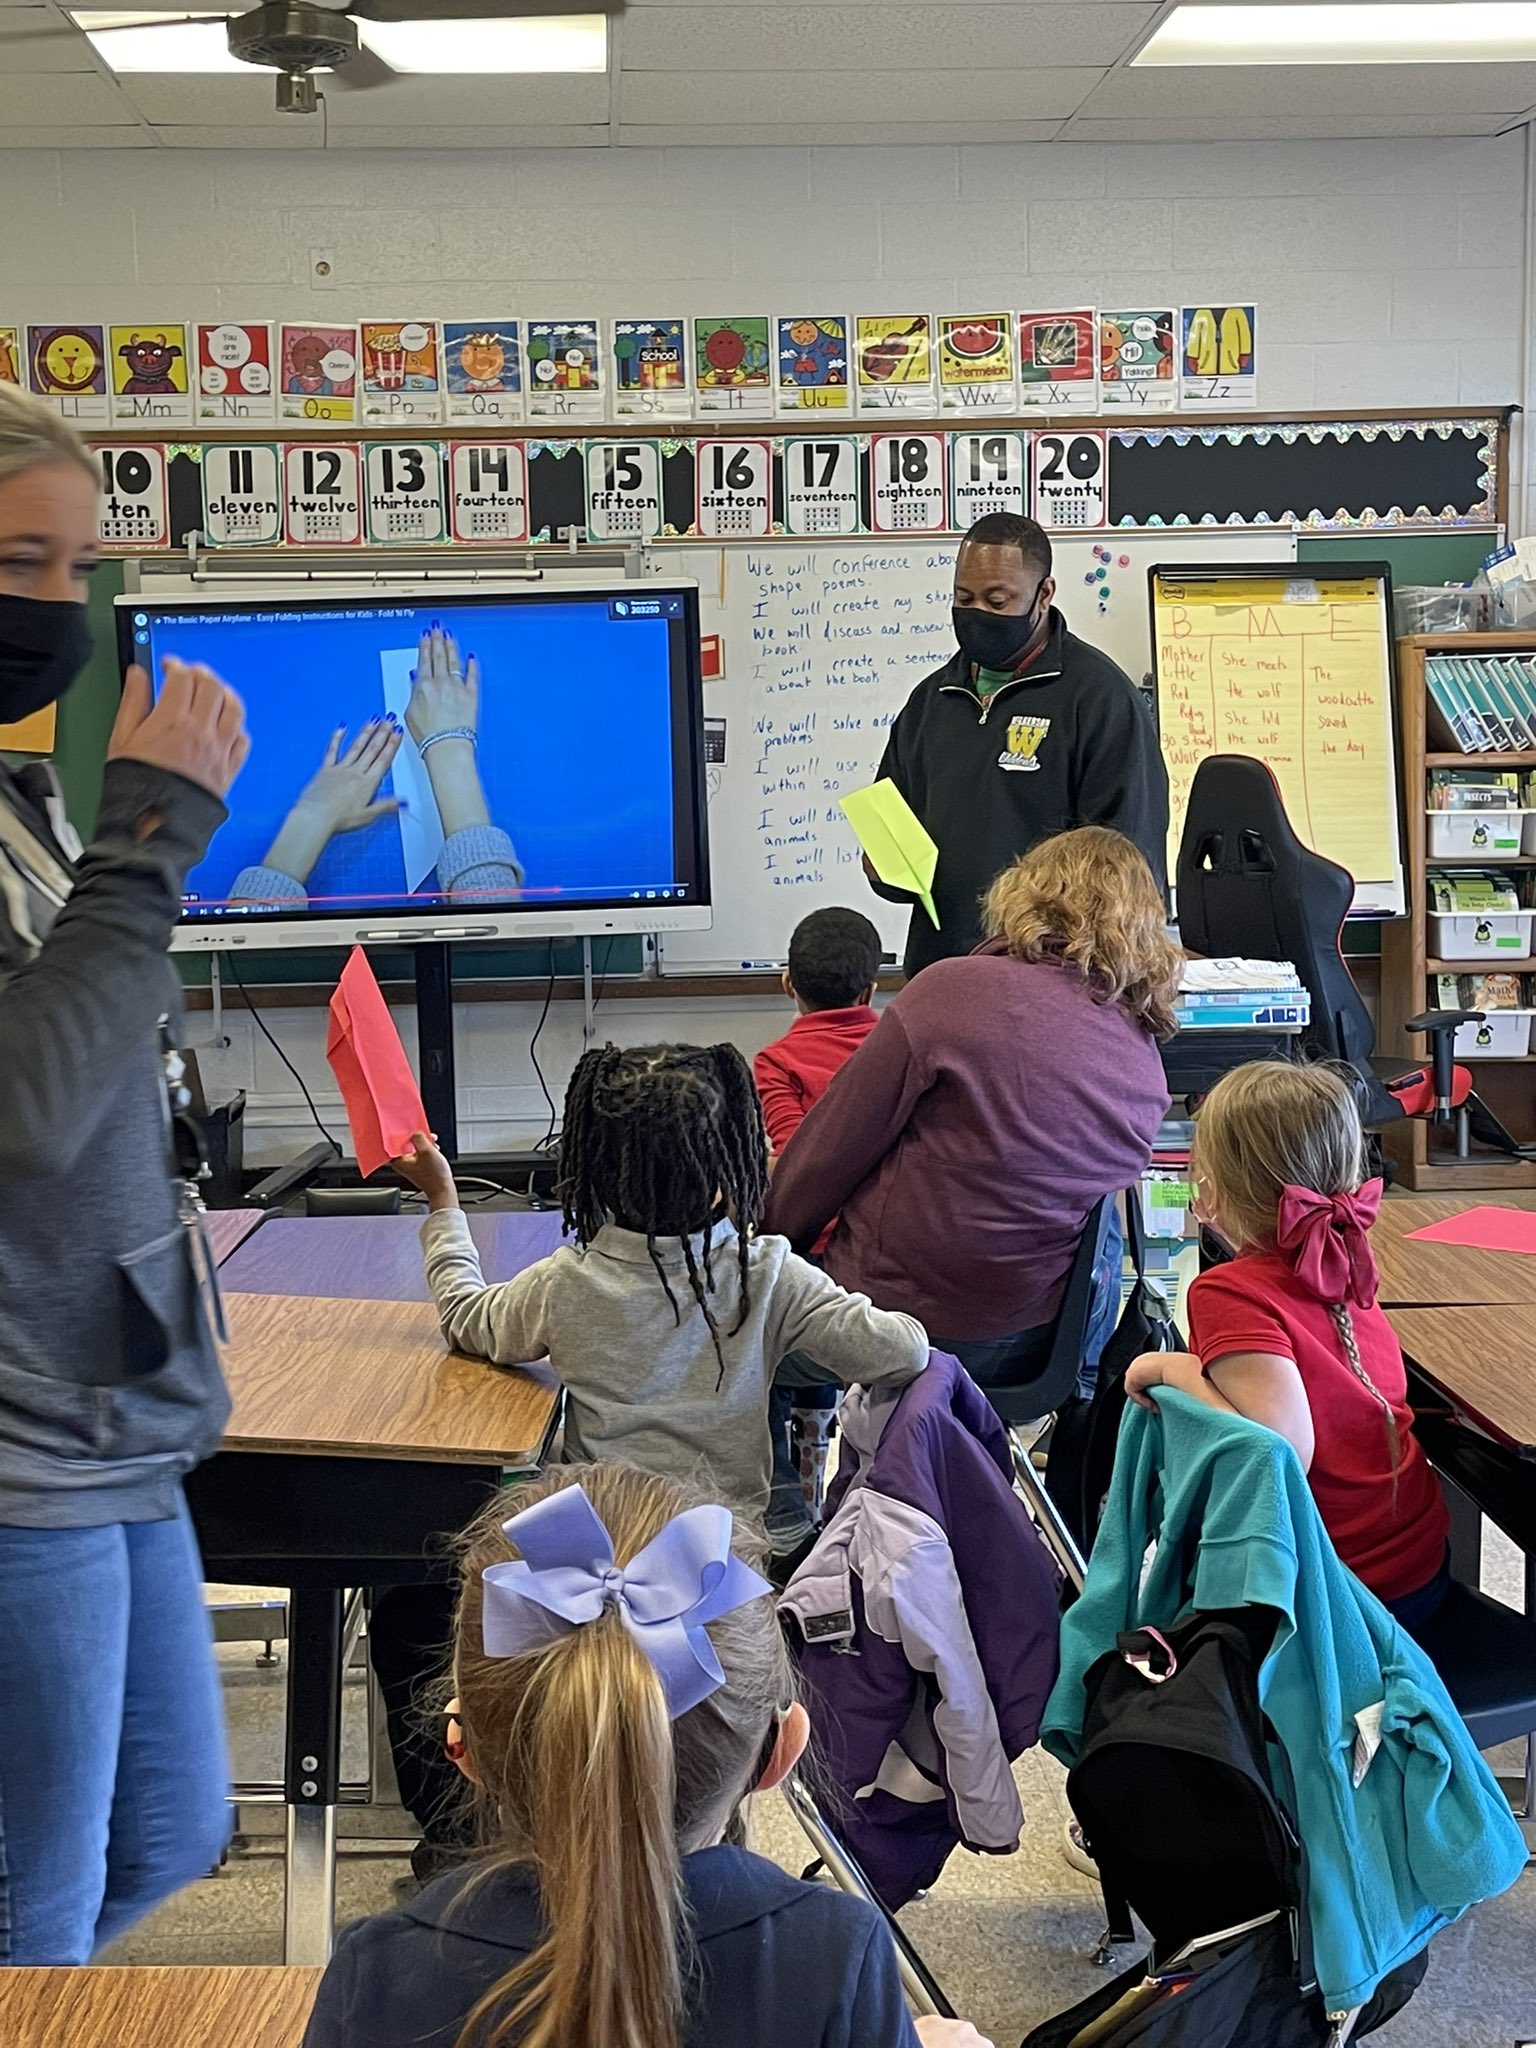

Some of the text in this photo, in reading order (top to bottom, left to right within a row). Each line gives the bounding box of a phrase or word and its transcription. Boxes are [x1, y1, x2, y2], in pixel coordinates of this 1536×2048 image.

[802, 388, 828, 408] Uu
[884, 388, 908, 408] Vv
[959, 386, 998, 406] Ww
[1048, 384, 1071, 404] Xx
[1126, 382, 1149, 406] Yy
[1207, 378, 1231, 399] Zz
[133, 396, 171, 418] Mm
[222, 396, 249, 418] Nn
[304, 398, 332, 420] Oo
[390, 394, 415, 416] Pp
[472, 394, 504, 420] Qq
[554, 393, 577, 415] Rr
[640, 394, 664, 413] Ss
[725, 389, 746, 410] Tt
[603, 447, 643, 491] 15
[713, 446, 755, 490] 16
[803, 443, 840, 488] 17
[889, 438, 929, 483] 18
[969, 437, 1008, 482] 19
[1039, 436, 1101, 481] 20
[102, 449, 152, 495] 10
[229, 449, 254, 494] 11
[303, 450, 342, 495] 12
[382, 448, 426, 493] 13
[468, 448, 509, 492] 14
[701, 490, 767, 508] sixteen
[789, 489, 857, 502] seventeen
[877, 483, 943, 503] eighteen
[956, 481, 1022, 497] nineteen
[1037, 480, 1103, 502] twenty
[107, 501, 151, 519] ten
[209, 496, 278, 514] eleven
[289, 491, 359, 514] twelve
[371, 492, 440, 511] thirteen
[455, 492, 525, 508] fourteen
[591, 491, 658, 510] fifteen
[747, 554, 774, 577] We
[788, 554, 817, 576] will
[926, 552, 955, 568] abo
[752, 590, 954, 618] I will create my shap
[753, 627, 776, 640] We
[787, 625, 811, 639] will
[881, 622, 902, 635] and
[1172, 604, 1362, 642] B M E
[1161, 645, 1205, 662] Mother
[1222, 651, 1247, 667] She
[752, 664, 767, 680] I
[781, 659, 812, 677] will
[833, 654, 874, 671] create
[905, 650, 952, 664] sentenc
[1310, 666, 1333, 683] The
[826, 673, 847, 686] the
[1226, 678, 1282, 698] the wolf
[789, 712, 816, 732] will
[832, 714, 861, 730] solve
[1262, 709, 1281, 726] told
[764, 733, 814, 756] problems
[1228, 731, 1279, 745] the wolf
[1320, 738, 1365, 761] the day
[753, 757, 768, 775] I
[786, 757, 820, 775] will
[836, 760, 858, 773] use
[762, 779, 840, 796] within 20
[1463, 791, 1492, 802] INSECTS
[757, 808, 774, 831] I
[789, 808, 816, 826] will
[763, 846, 861, 870] I will list
